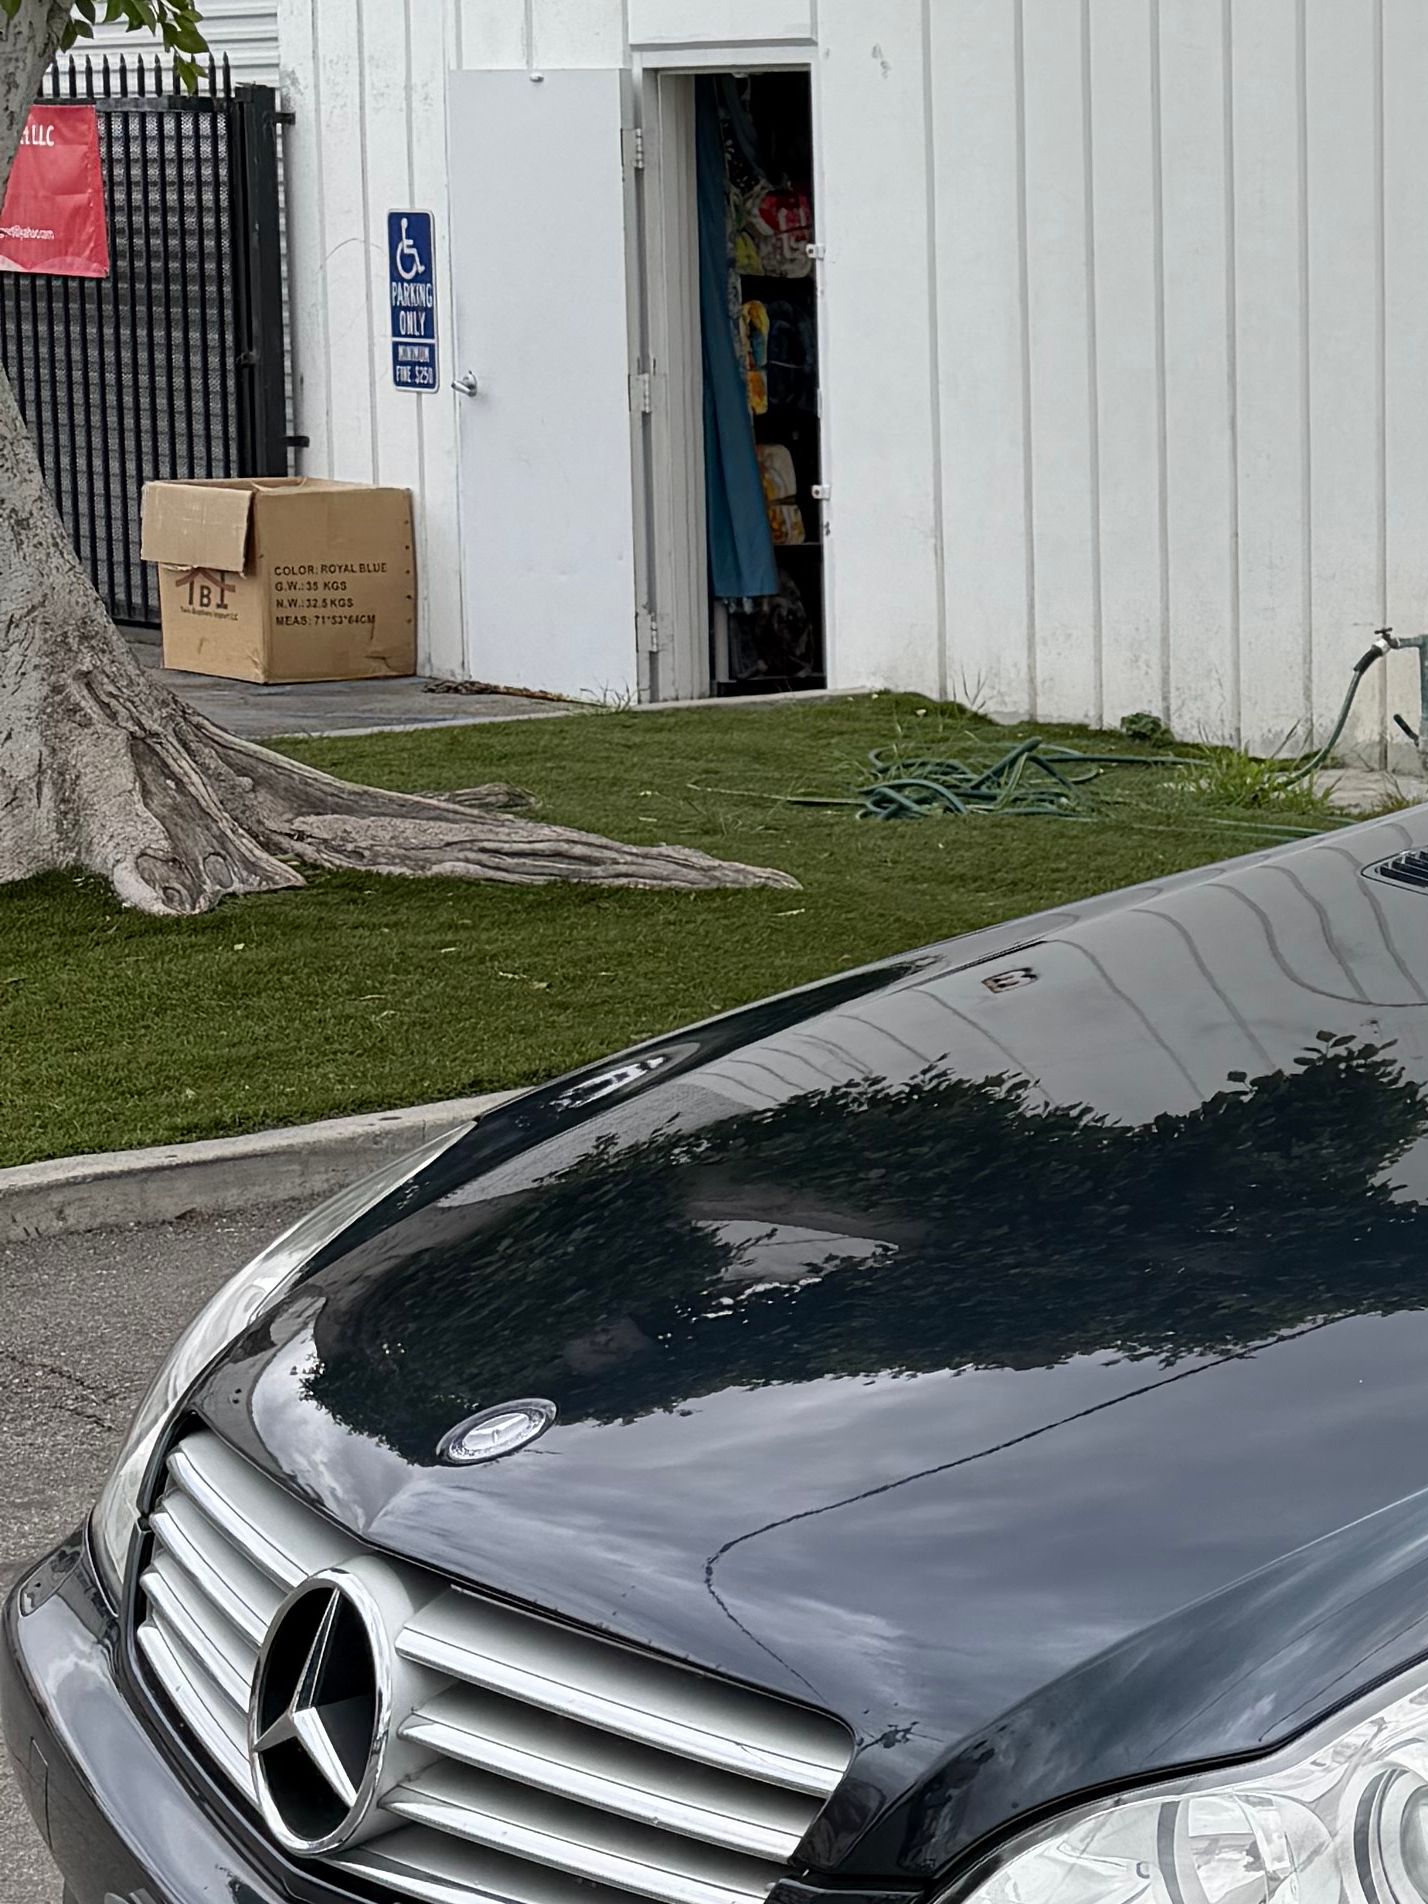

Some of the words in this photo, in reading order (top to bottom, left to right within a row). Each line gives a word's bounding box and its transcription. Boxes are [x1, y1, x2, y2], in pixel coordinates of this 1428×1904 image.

[32, 124, 55, 146] LLC
[392, 281, 433, 307] PARKING
[400, 311, 426, 336] ONLY
[396, 366, 411, 382] FINE
[415, 366, 433, 384] $250
[274, 565, 318, 576] COLOR:
[321, 564, 357, 574] ROYAL
[359, 563, 387, 573] BLUE
[324, 581, 347, 591] KGS
[330, 598, 354, 608] KGS
[276, 616, 311, 625] MEAS:
